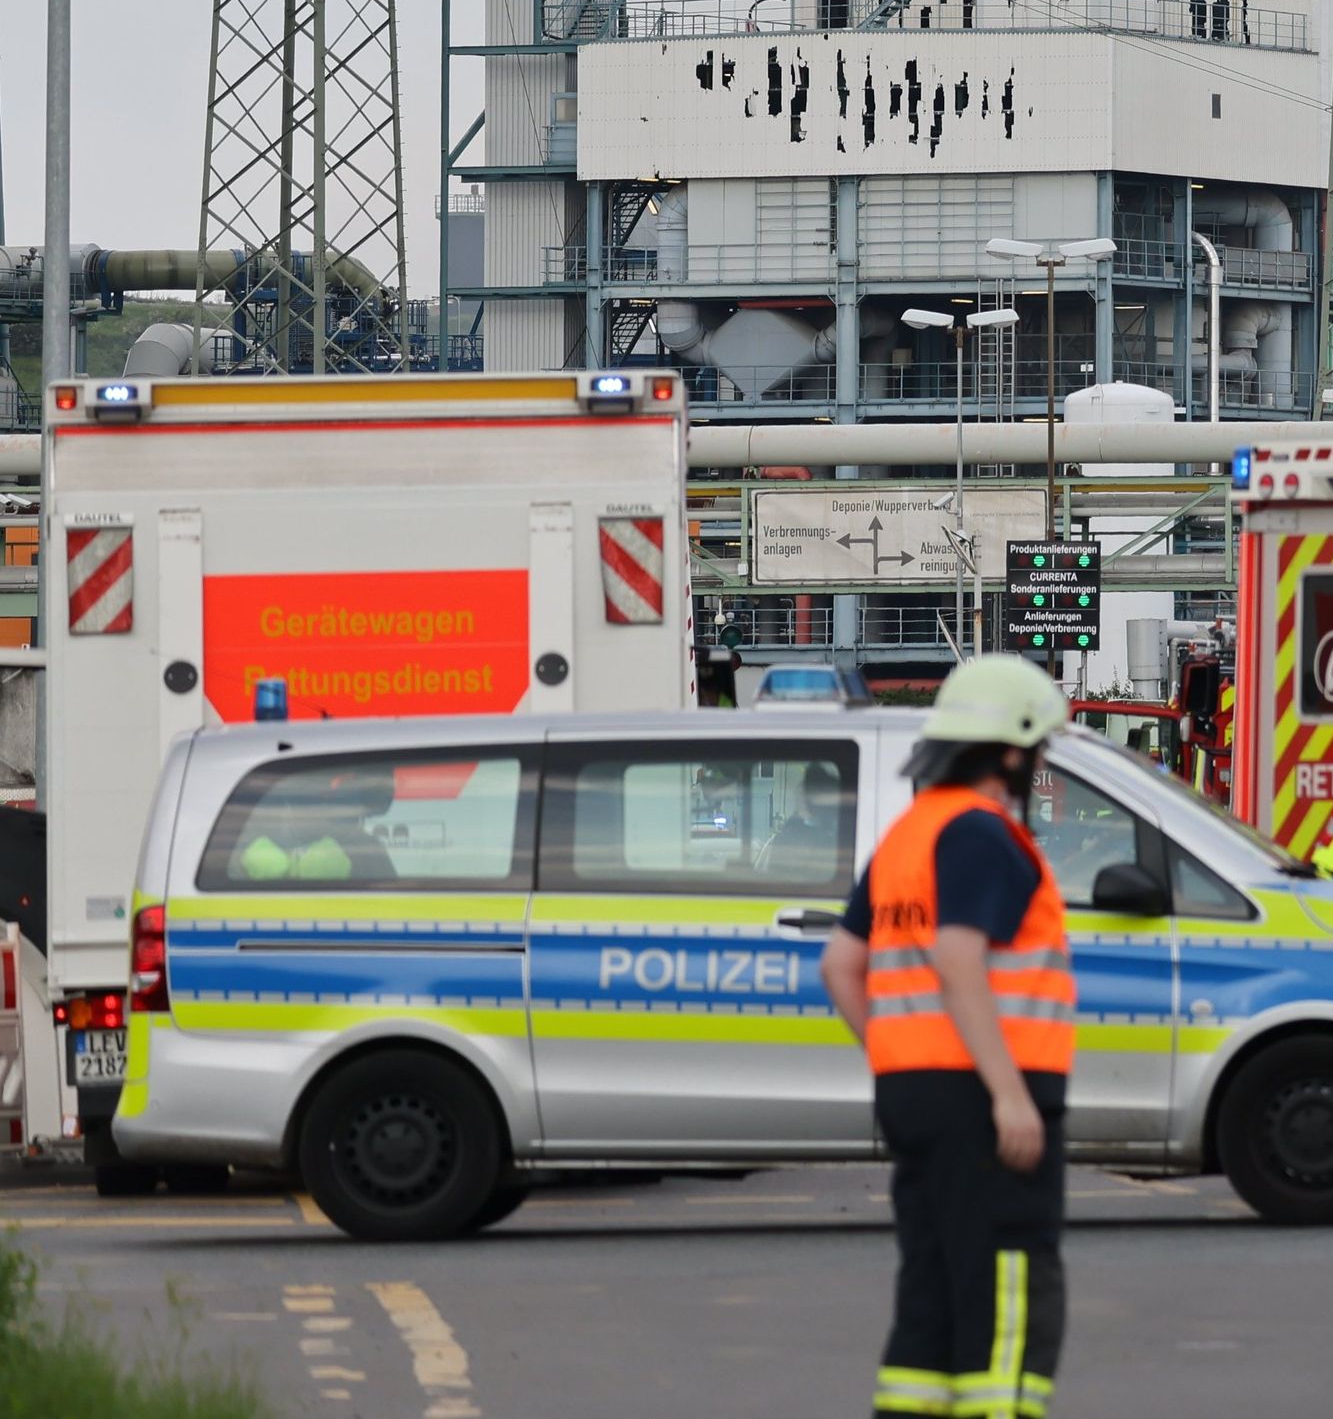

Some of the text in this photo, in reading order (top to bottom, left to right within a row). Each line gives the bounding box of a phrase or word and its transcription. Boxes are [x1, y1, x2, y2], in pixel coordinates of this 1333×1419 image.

[763, 525, 837, 541] Verbrennungs-
[763, 542, 802, 558] anlagen
[1010, 544, 1098, 555] Produktanlieferungen
[1029, 572, 1078, 581] CURRENTA
[1010, 583, 1097, 595] Sonderanlieferungen
[260, 604, 475, 643] Gerätewagen
[1024, 611, 1082, 622] Anlieferungen
[1009, 623, 1097, 635] Deponie/Verbrennung
[244, 663, 493, 703] Rttungsdienst
[600, 947, 799, 994] POLIZEI
